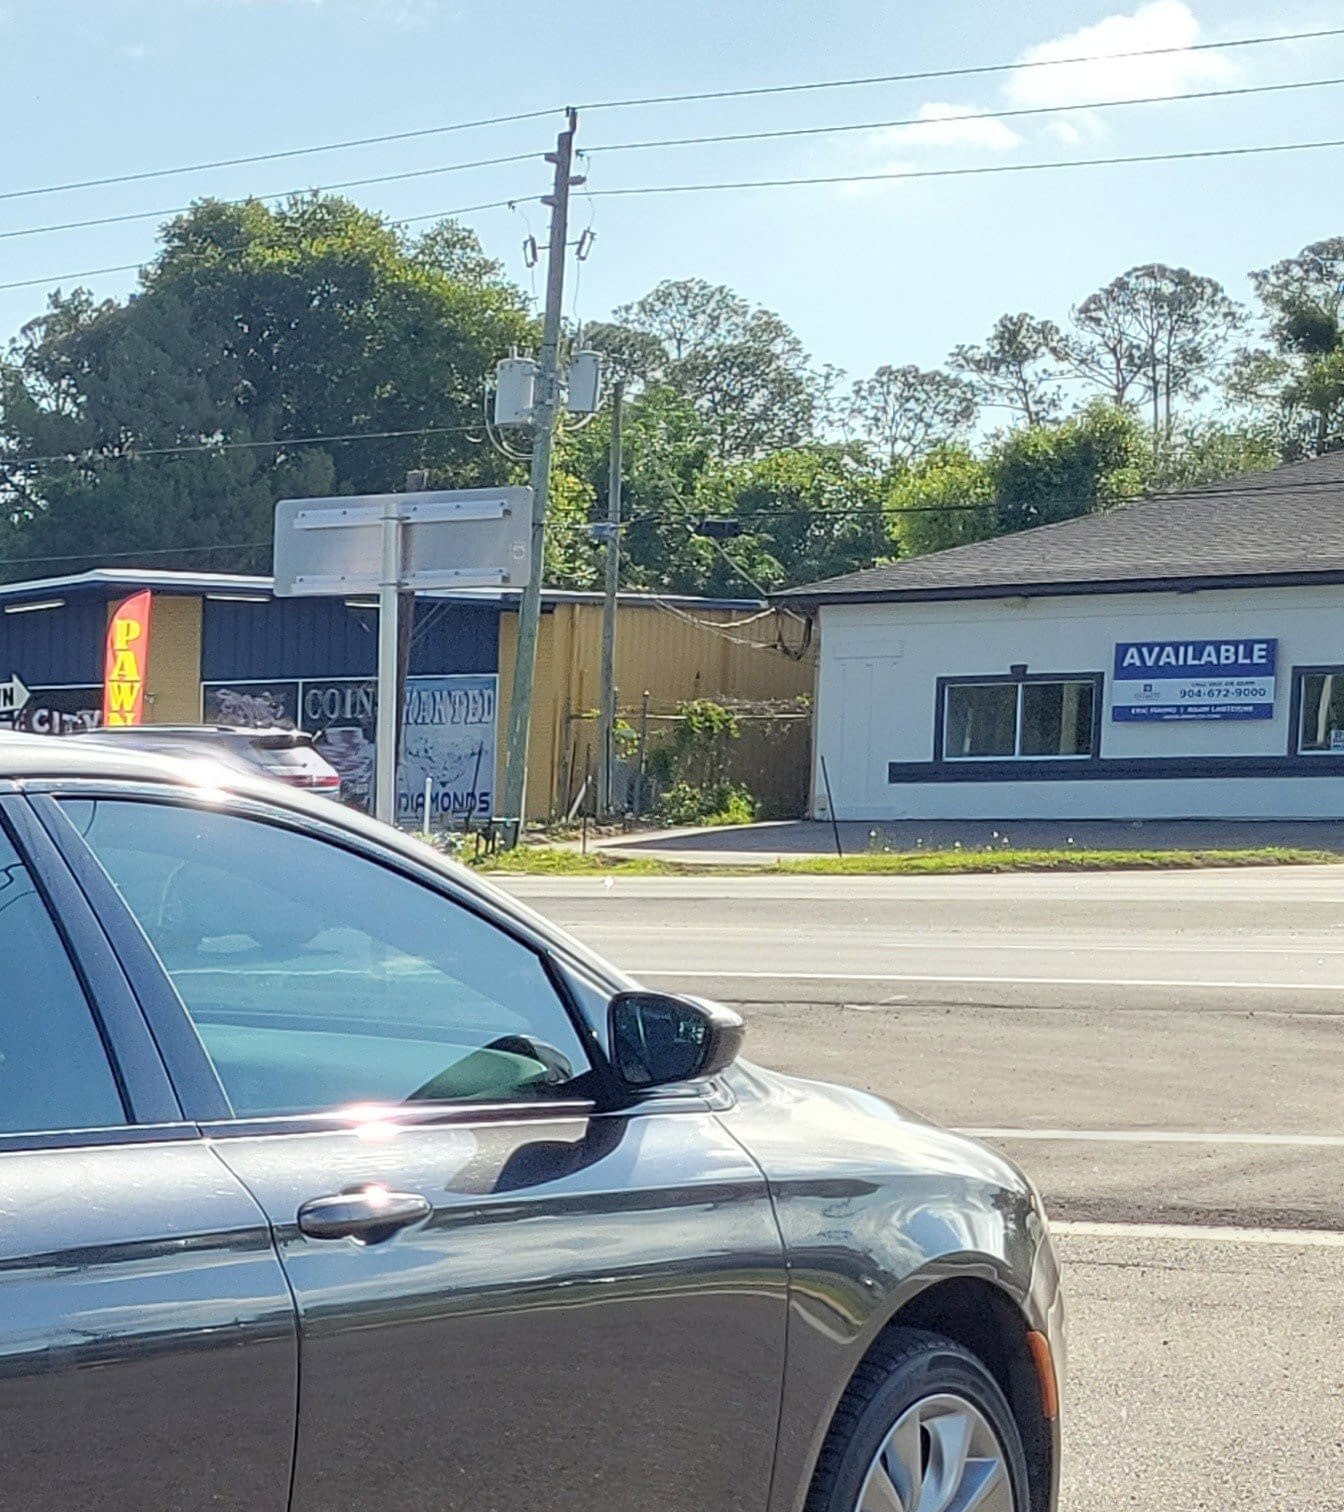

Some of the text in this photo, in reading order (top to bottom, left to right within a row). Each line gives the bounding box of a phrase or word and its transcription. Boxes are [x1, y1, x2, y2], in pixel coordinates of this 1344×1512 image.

[1122, 643, 1268, 667] AVAILABLE
[305, 688, 378, 719] COIN
[398, 792, 490, 812] DIAMONDS
